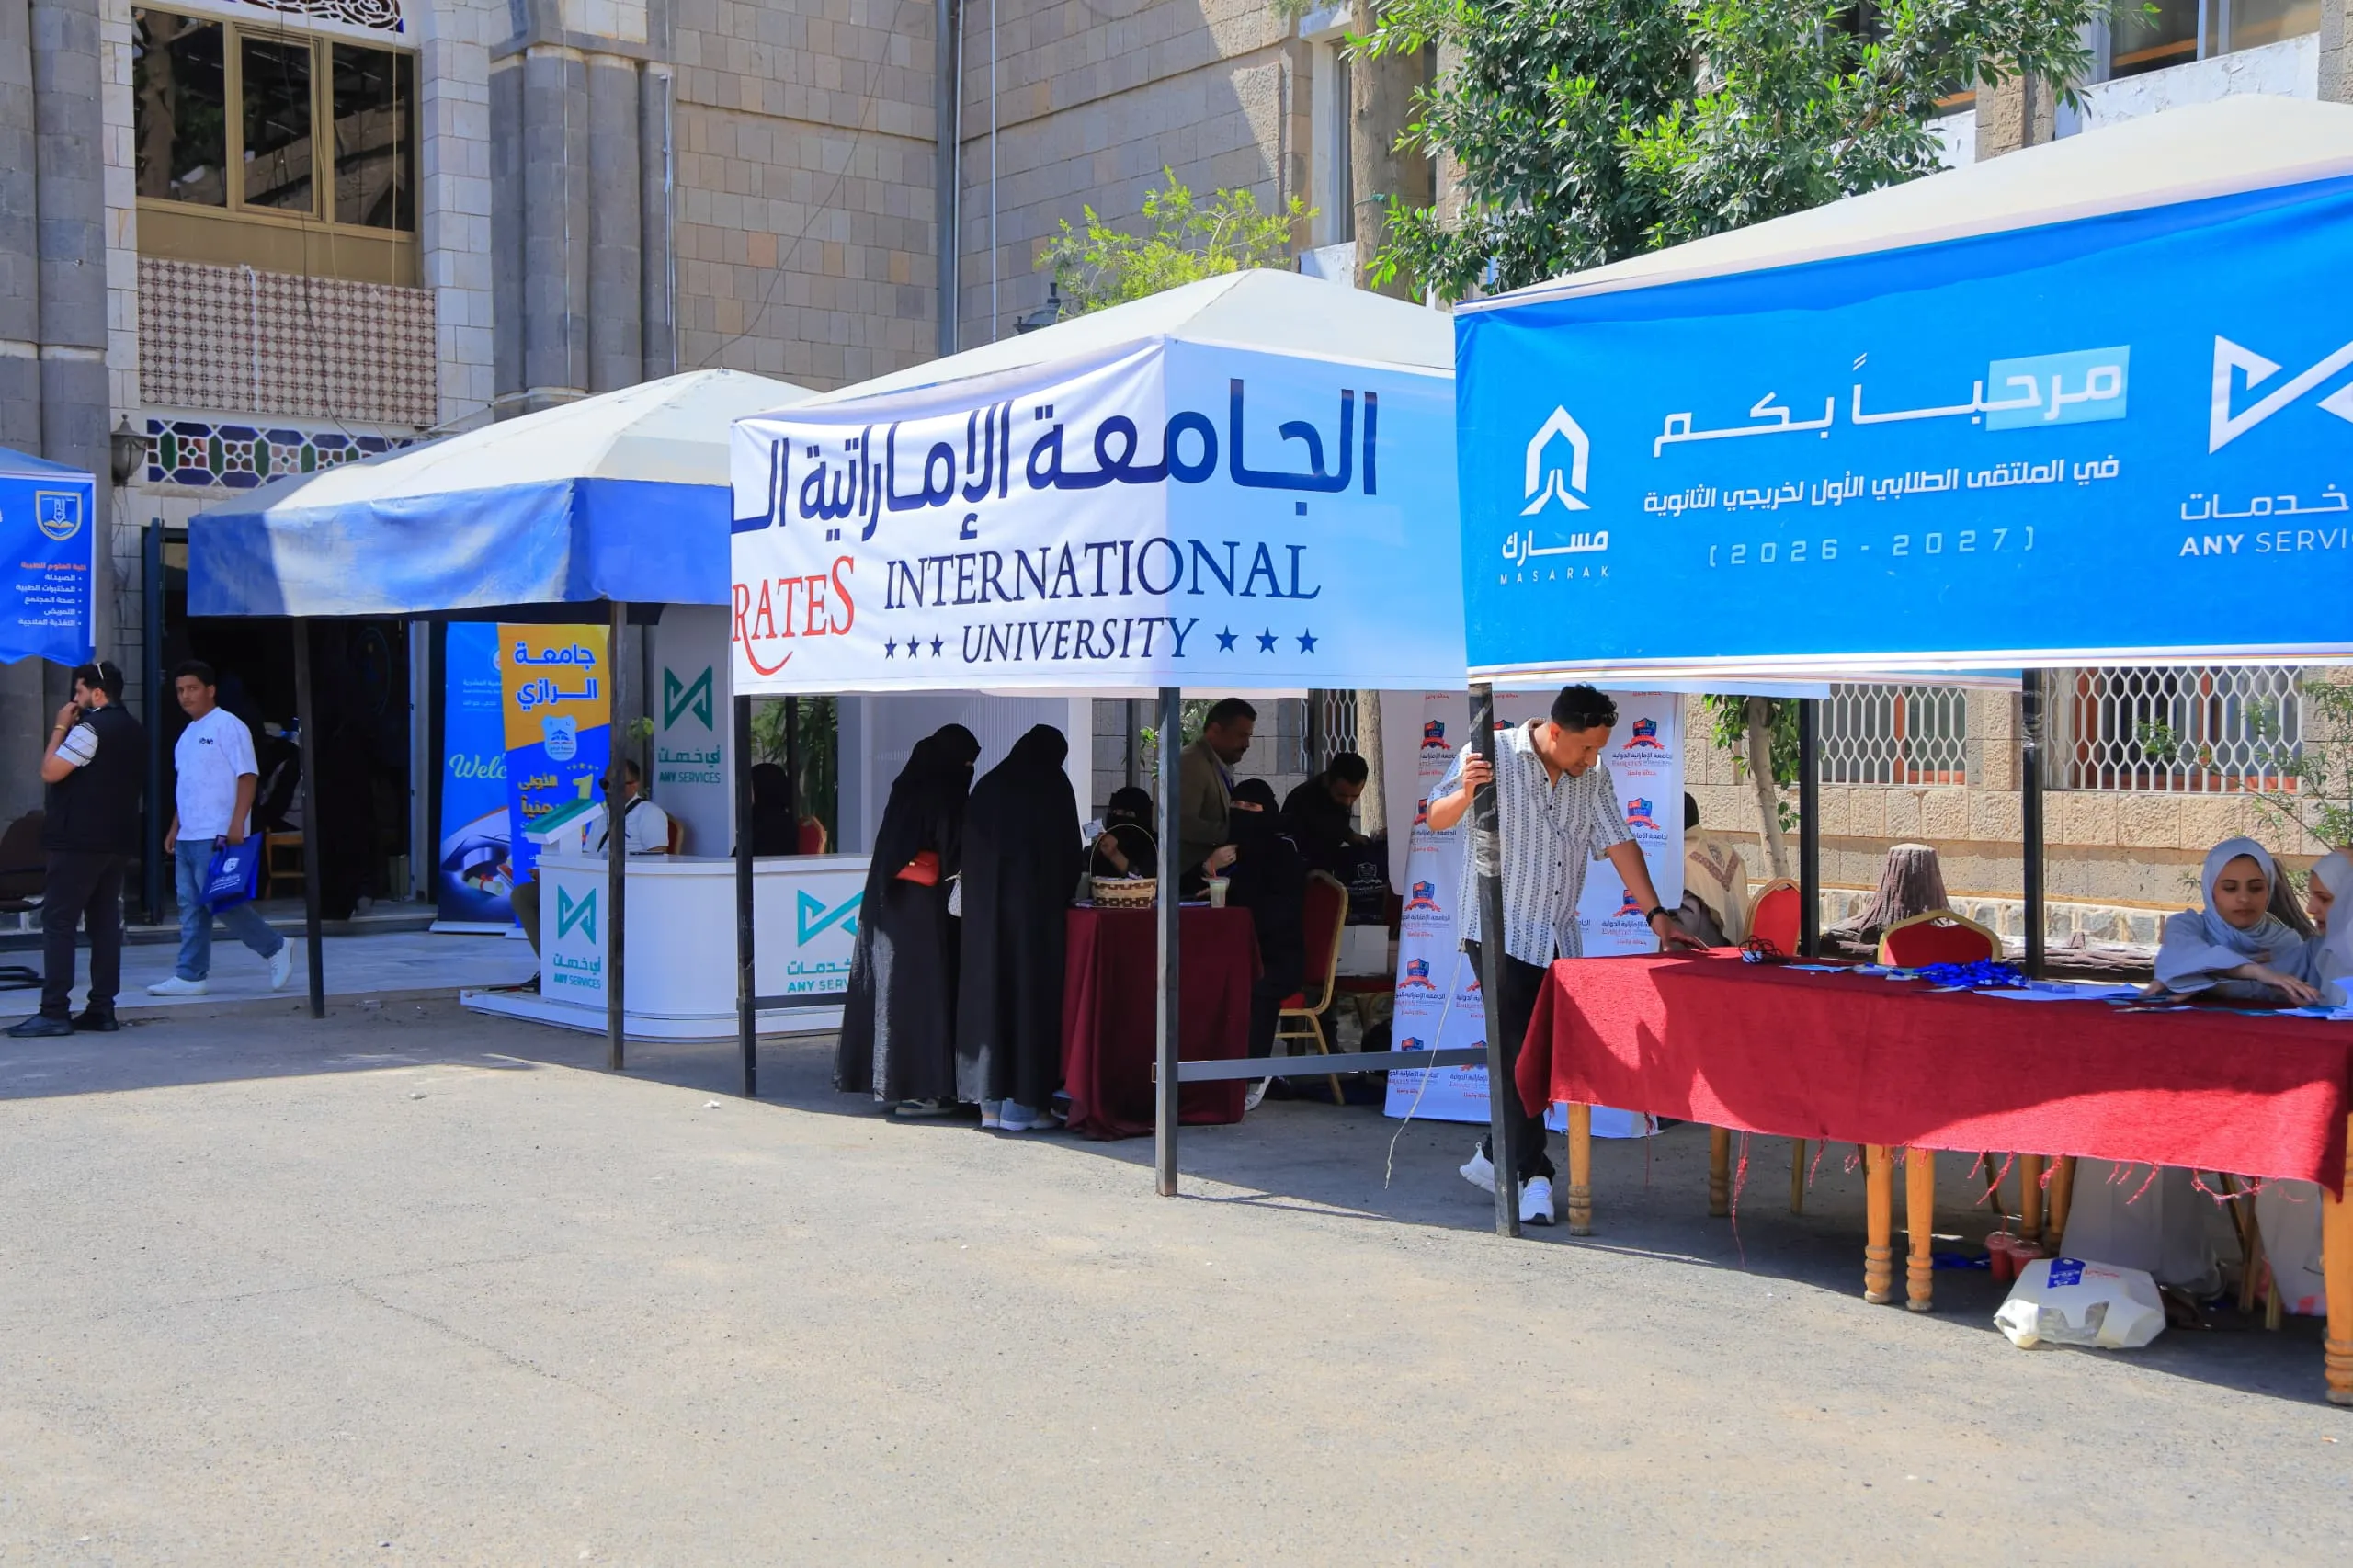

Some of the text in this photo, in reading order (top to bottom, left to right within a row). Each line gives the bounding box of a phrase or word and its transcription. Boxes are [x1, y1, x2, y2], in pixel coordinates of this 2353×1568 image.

[1654, 392, 1835, 458] بكم
[731, 378, 1377, 541] الجامعة الإماراتية ال
[1644, 454, 2120, 517] في الملتقى الطلابي الأول لخريجي الثانوية
[2181, 483, 2349, 520] خدمات
[1502, 529, 1608, 567] مسارك
[2179, 528, 2353, 556] ANY SERVI
[1500, 566, 1608, 585] MASARAK
[732, 537, 1322, 676] RATES INTERNATIONAL
[513, 641, 597, 672] جامعة
[962, 617, 1199, 663] UNIVERSITY
[516, 677, 599, 712] الرازي
[658, 744, 721, 768] أي خدمات
[659, 772, 721, 784] ANY SERVICES
[553, 952, 588, 971] خدمات
[569, 975, 601, 990] SERVICES
[788, 980, 815, 993] ANY
